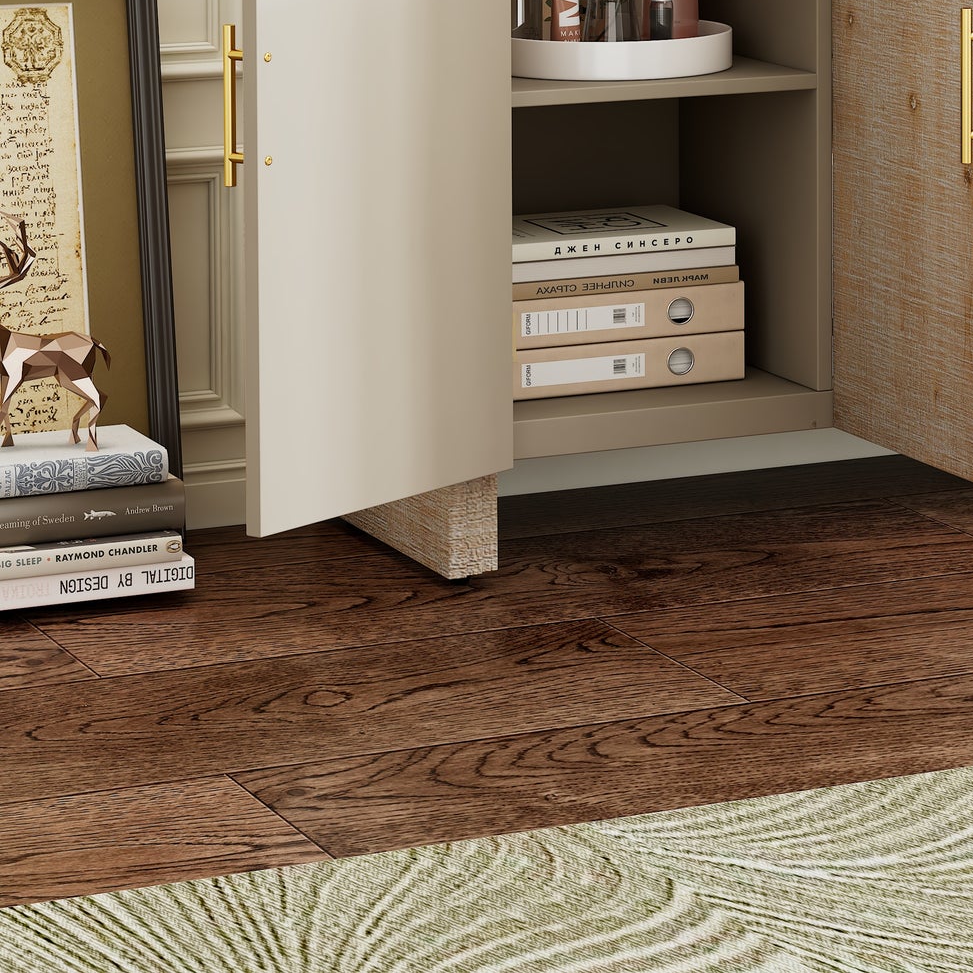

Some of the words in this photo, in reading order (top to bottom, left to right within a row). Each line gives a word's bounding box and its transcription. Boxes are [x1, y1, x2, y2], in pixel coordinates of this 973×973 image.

[554, 244, 601, 255] ДЖЕН
[615, 236, 693, 250] СИНСЕРО
[0, 518, 31, 530] eaming
[33, 516, 41, 526] of
[42, 515, 75, 525] Sweden
[125, 507, 150, 515] Andrew
[152, 504, 174, 513] Brown
[0, 560, 12, 568] IG
[16, 557, 42, 567] SLEEP
[55, 550, 105, 563] RAYMOND
[108, 544, 158, 557] CHANDLER
[60, 575, 109, 595] DESIGN
[117, 572, 133, 588] BY
[141, 565, 194, 585] DIGITAL
